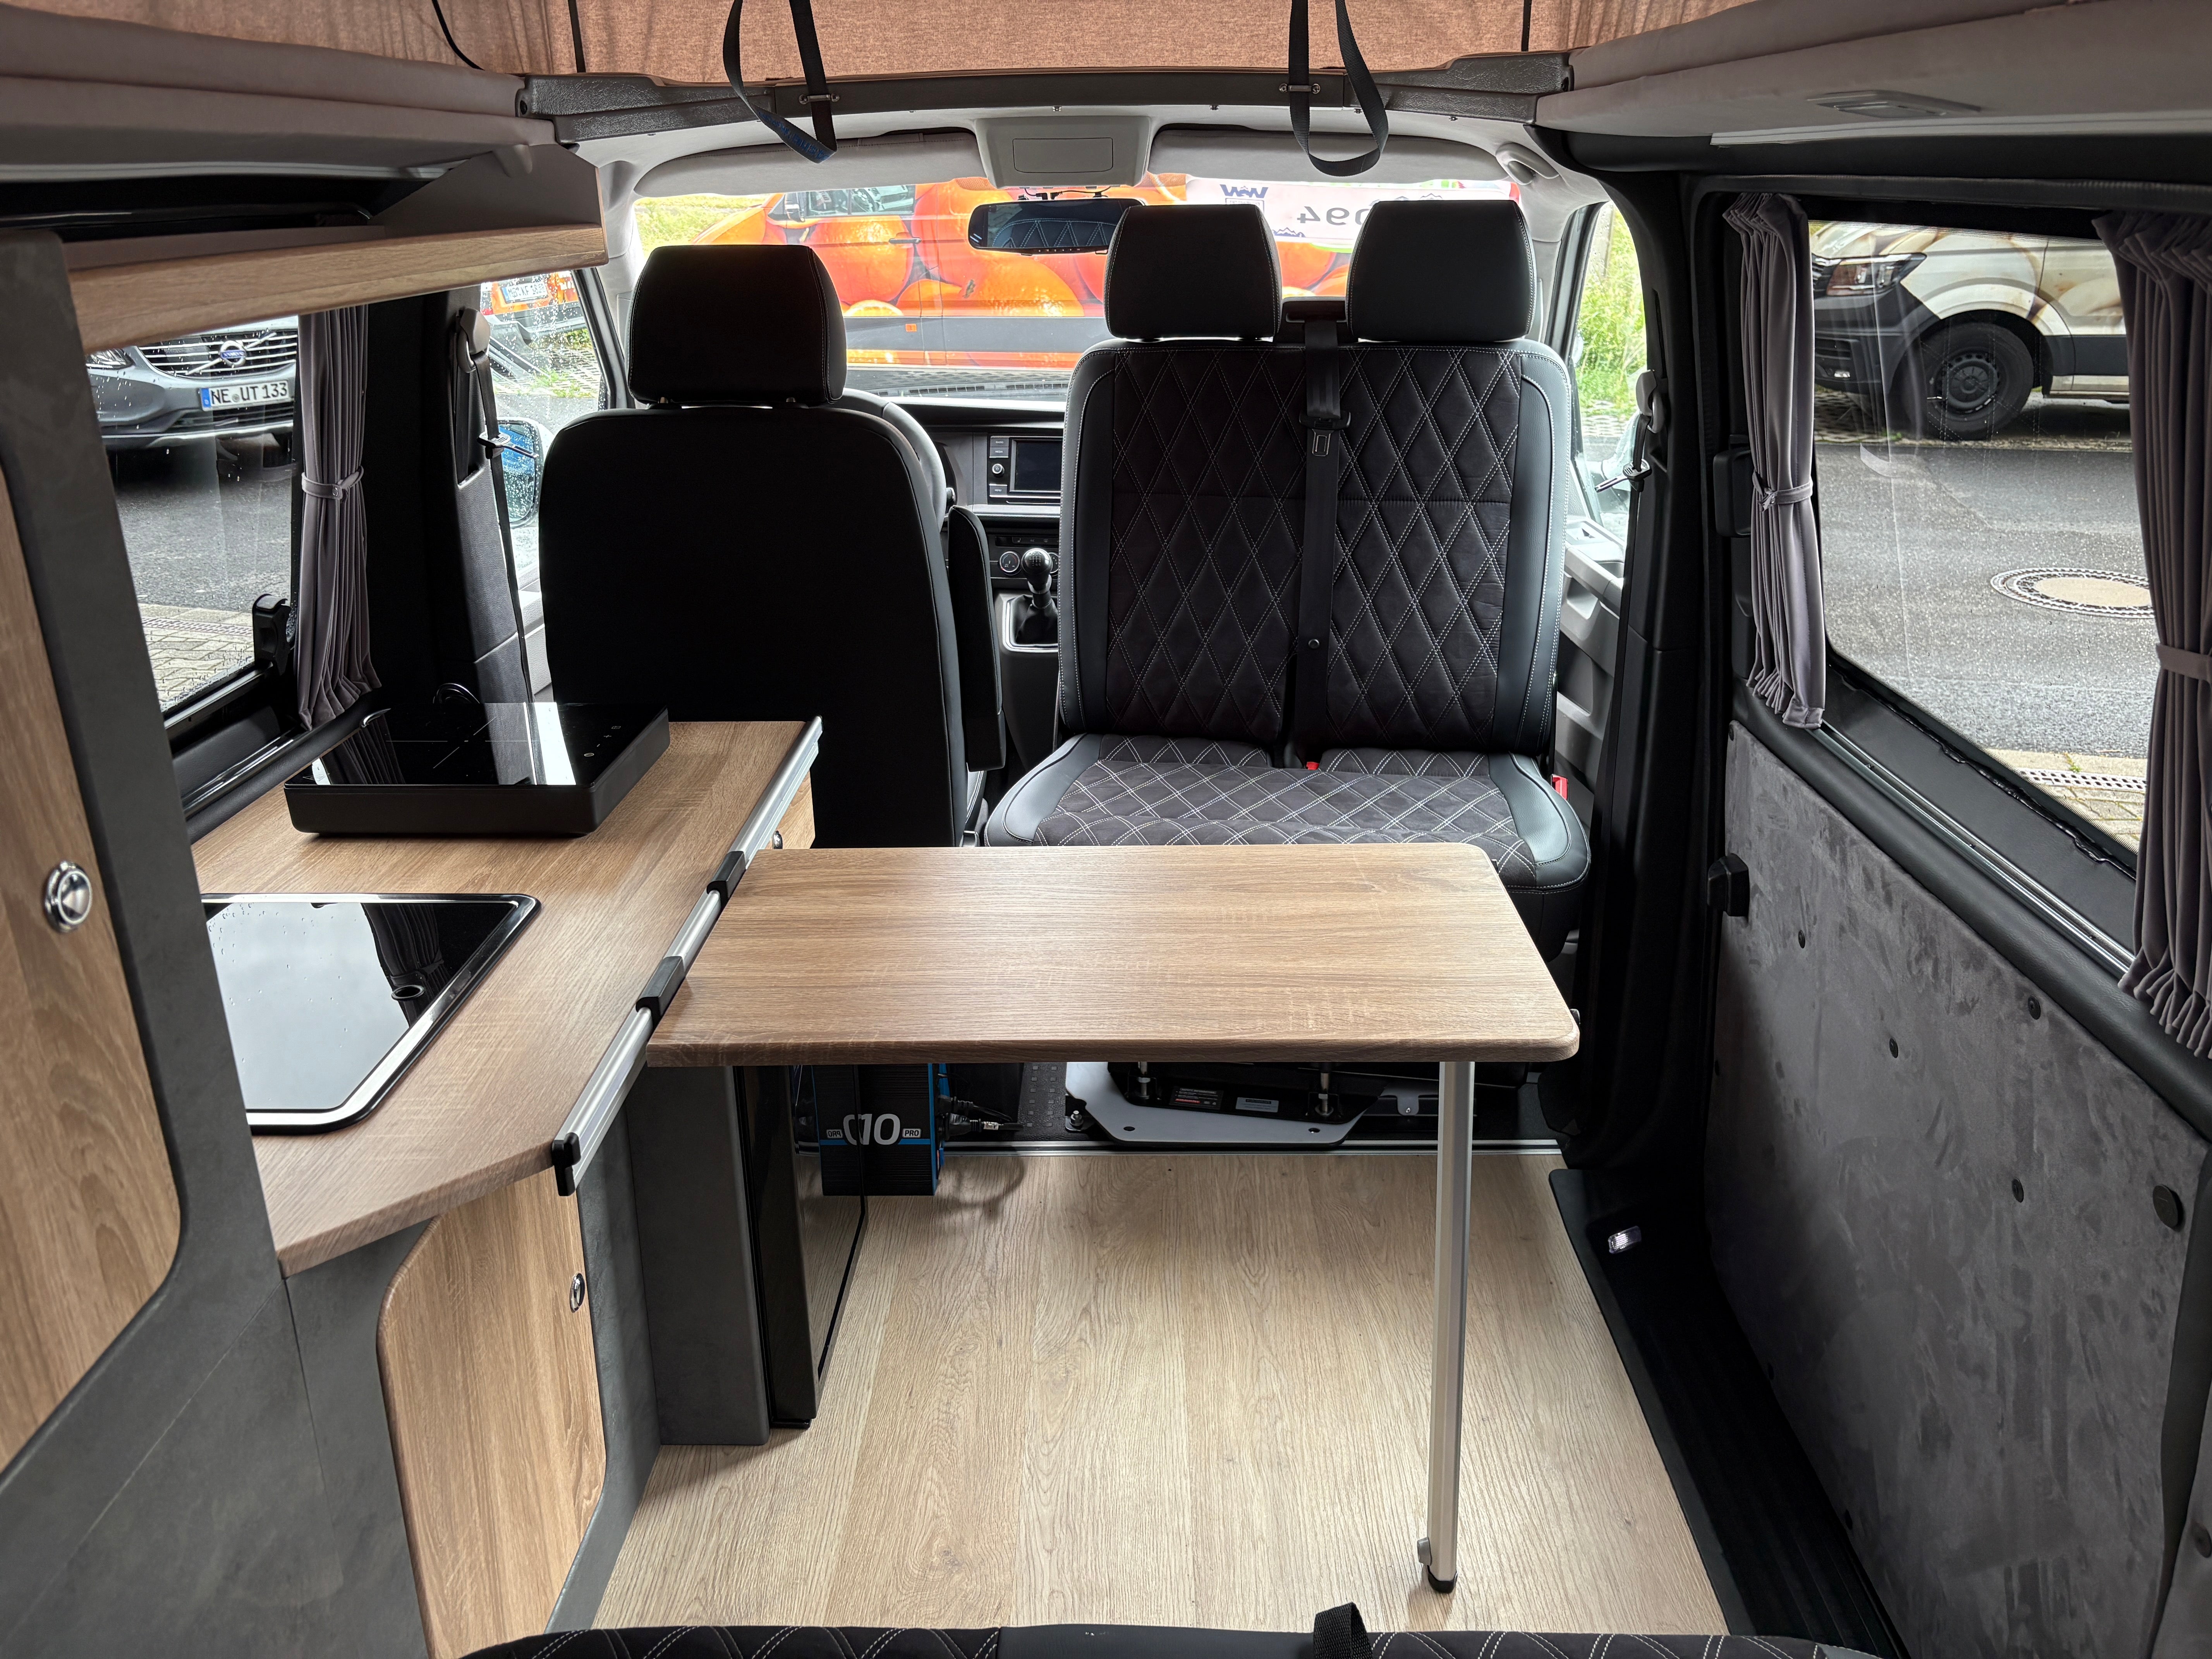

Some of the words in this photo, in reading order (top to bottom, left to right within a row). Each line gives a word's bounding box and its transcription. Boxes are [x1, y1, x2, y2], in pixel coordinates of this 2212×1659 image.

[211, 388, 230, 404] NE
[240, 386, 259, 401] UT
[262, 383, 287, 399] 133
